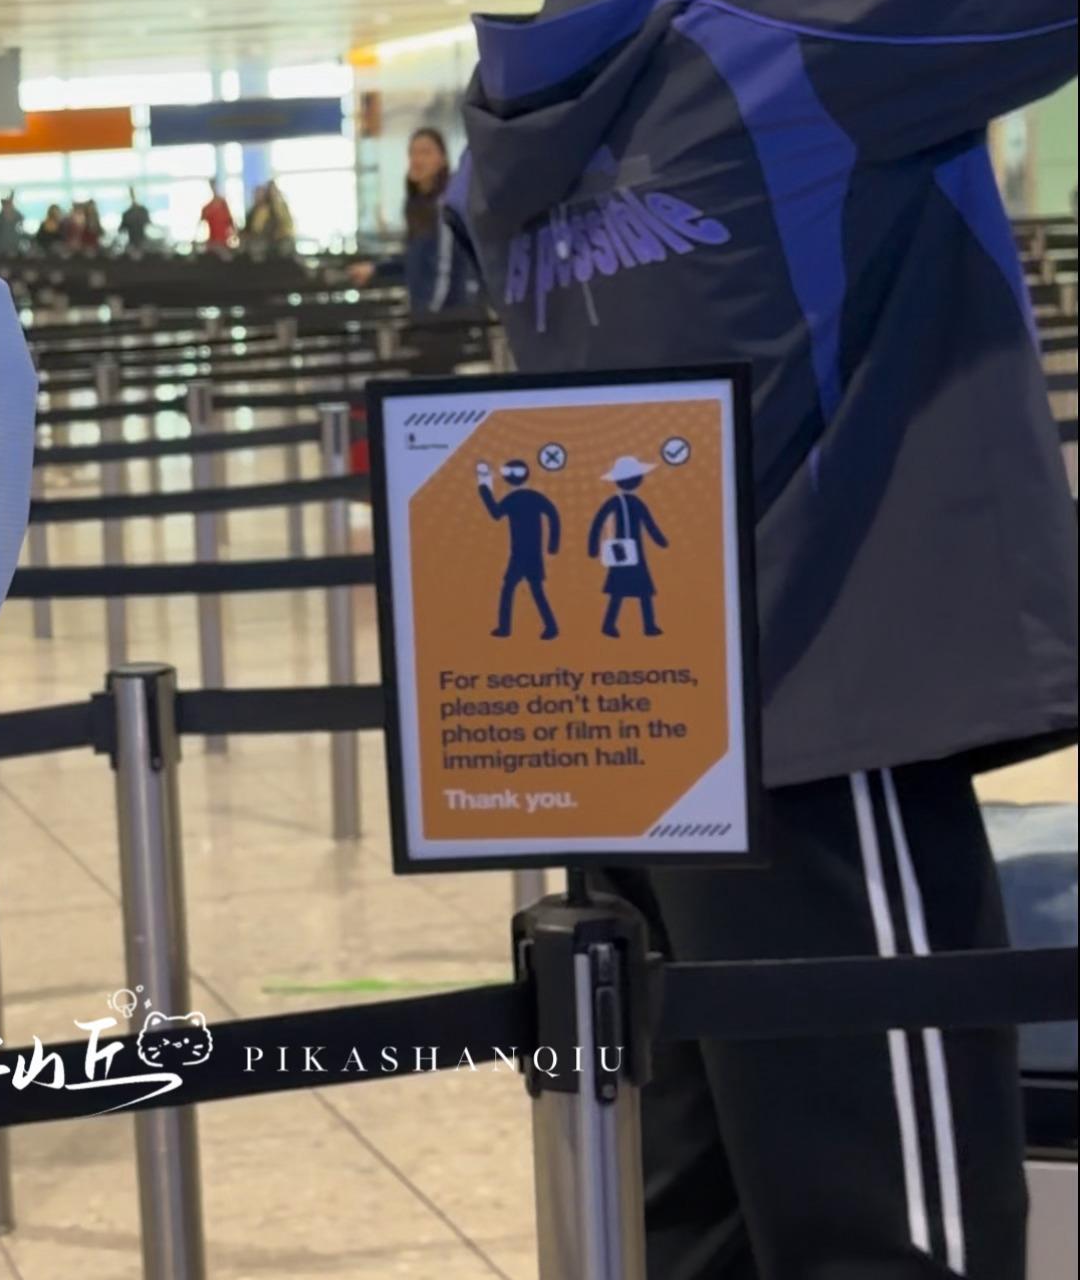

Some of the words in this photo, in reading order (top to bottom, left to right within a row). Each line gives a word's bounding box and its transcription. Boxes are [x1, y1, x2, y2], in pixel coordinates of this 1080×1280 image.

[440, 671, 479, 690] For
[487, 668, 584, 691] security
[591, 668, 698, 686] reasons,
[441, 697, 519, 720] please
[527, 694, 589, 714] don't
[598, 693, 651, 712] take
[442, 723, 525, 746] photos
[533, 726, 558, 741] or
[566, 721, 612, 740] film
[619, 720, 640, 739] in
[649, 720, 687, 738] the
[443, 748, 588, 772] immigration
[595, 747, 645, 766] hall.
[443, 789, 519, 809] Thank
[526, 791, 578, 813] you.
